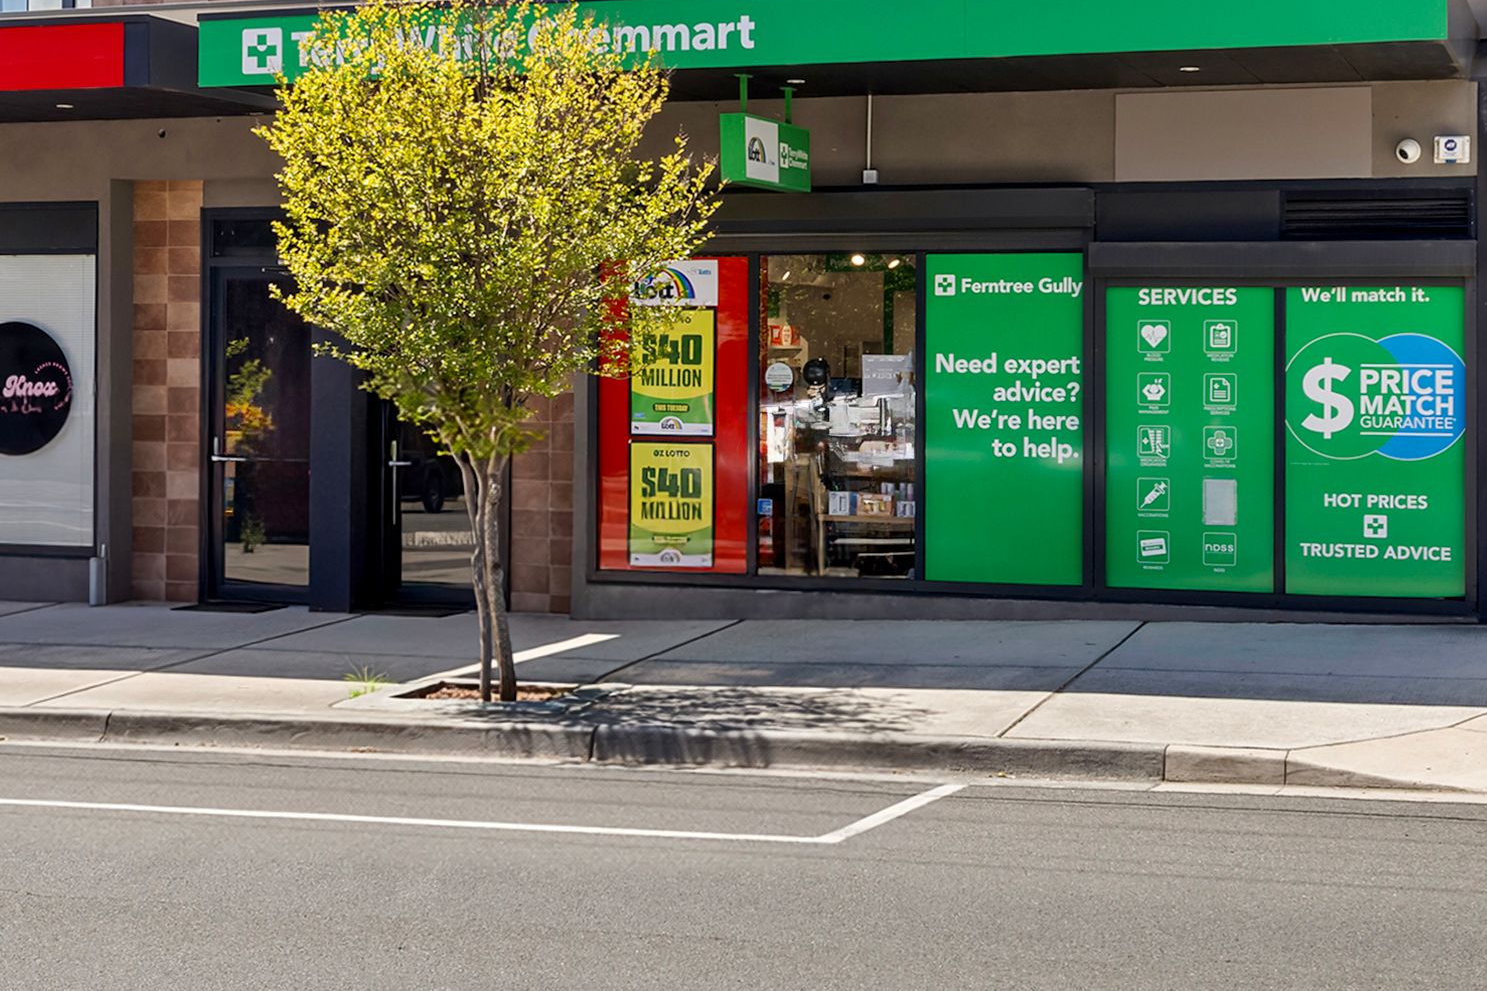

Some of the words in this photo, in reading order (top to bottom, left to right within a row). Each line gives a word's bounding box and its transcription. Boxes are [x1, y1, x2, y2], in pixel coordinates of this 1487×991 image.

[527, 15, 755, 58] Cemmart
[961, 278, 1033, 294] Ferntree
[1038, 277, 1082, 297] Gully
[1138, 288, 1237, 305] SERVICES
[1301, 287, 1346, 303] We'll
[1351, 287, 1406, 303] match
[1411, 287, 1430, 302] it.
[642, 334, 702, 365] $40
[935, 352, 997, 373] Need
[1004, 356, 1080, 379] expert
[3, 375, 59, 398] Knox
[641, 369, 702, 387] MILLION
[1360, 369, 1454, 394] PRICE
[993, 380, 1080, 402] advice?
[1360, 395, 1454, 416] MATCH
[952, 409, 1021, 429] We're
[1028, 408, 1079, 430] here
[1360, 416, 1454, 429] GUARANTEE
[991, 439, 1017, 457] to
[1023, 437, 1079, 464] help.
[641, 466, 702, 498] $40
[641, 501, 702, 521] MILLION
[1324, 493, 1362, 508] HOT
[1367, 494, 1428, 509] PRICES
[1300, 543, 1379, 558] TRUSTED
[1384, 545, 1452, 561] ADVICE
